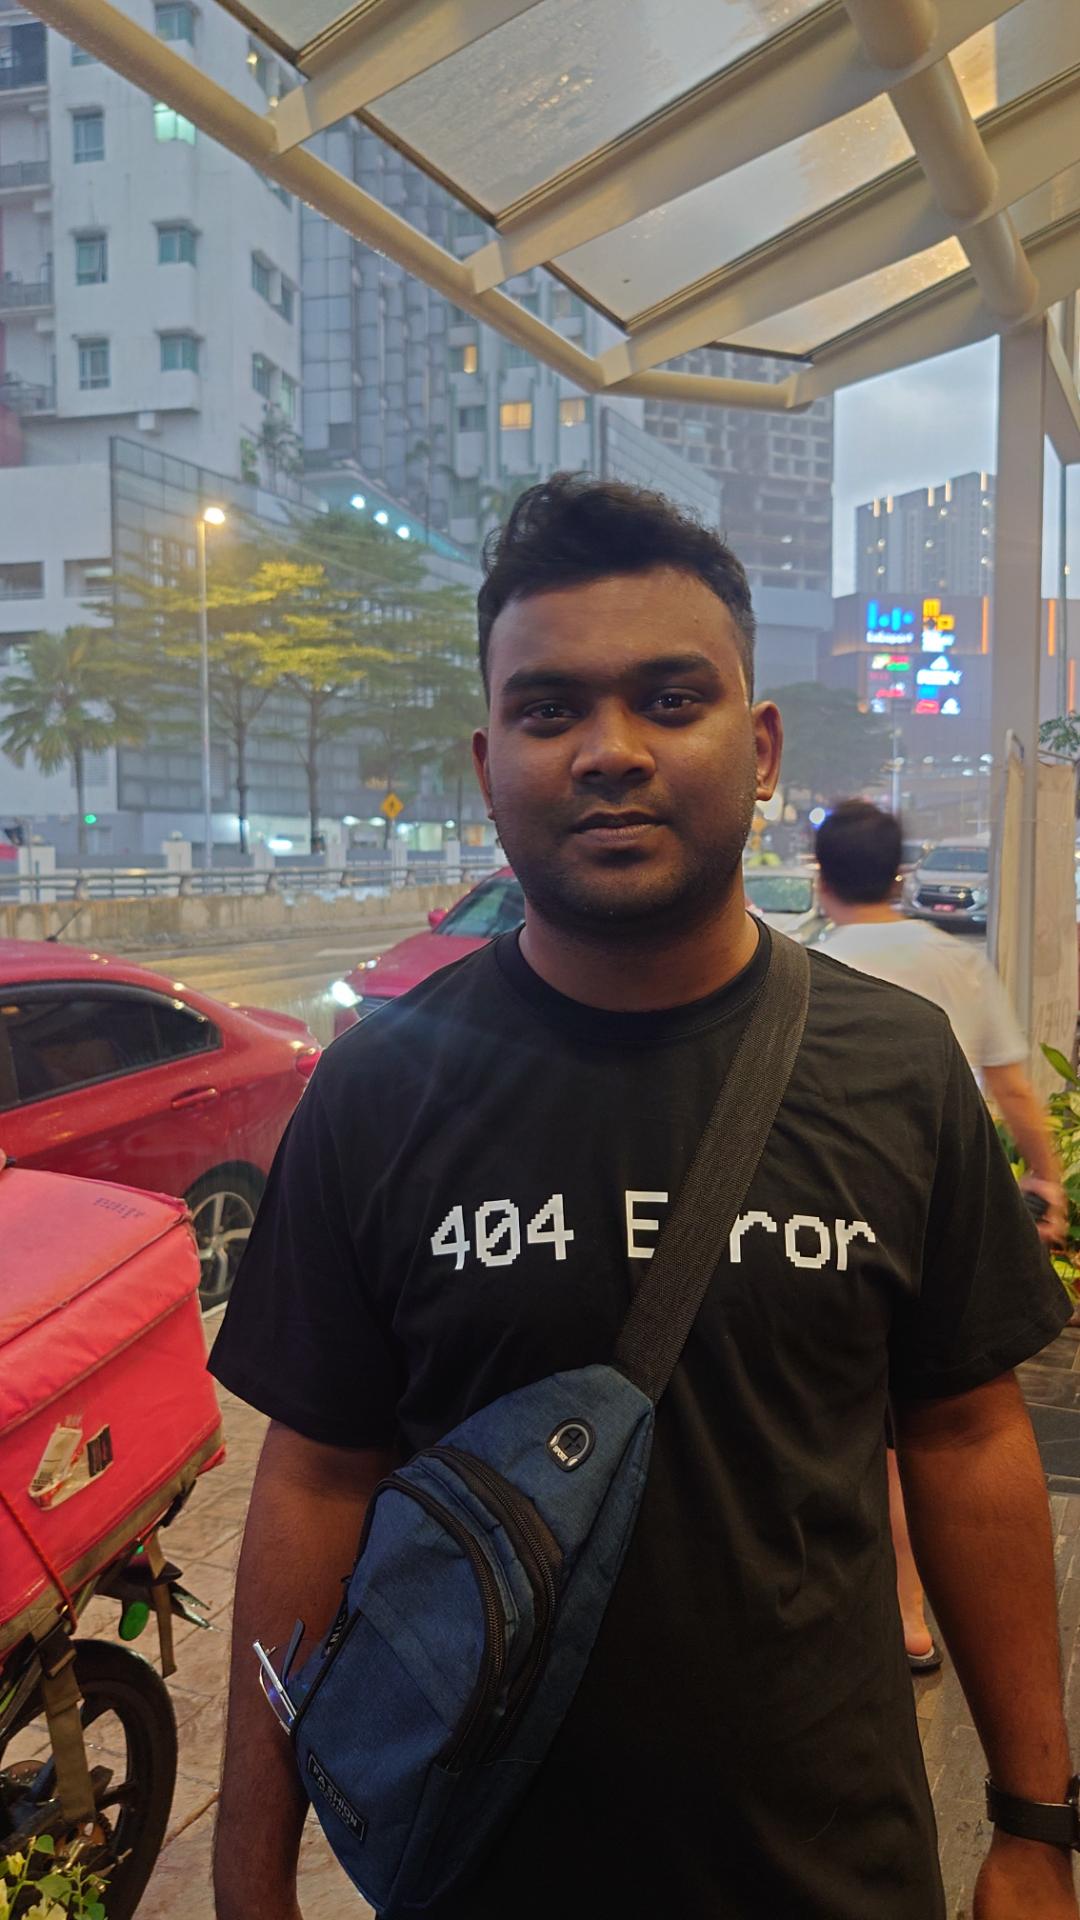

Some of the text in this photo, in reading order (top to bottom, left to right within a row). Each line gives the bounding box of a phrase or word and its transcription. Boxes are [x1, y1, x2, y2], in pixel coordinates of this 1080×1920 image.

[430, 1190, 876, 1271] 404 Eror
[312, 1764, 358, 1827] FASHION
